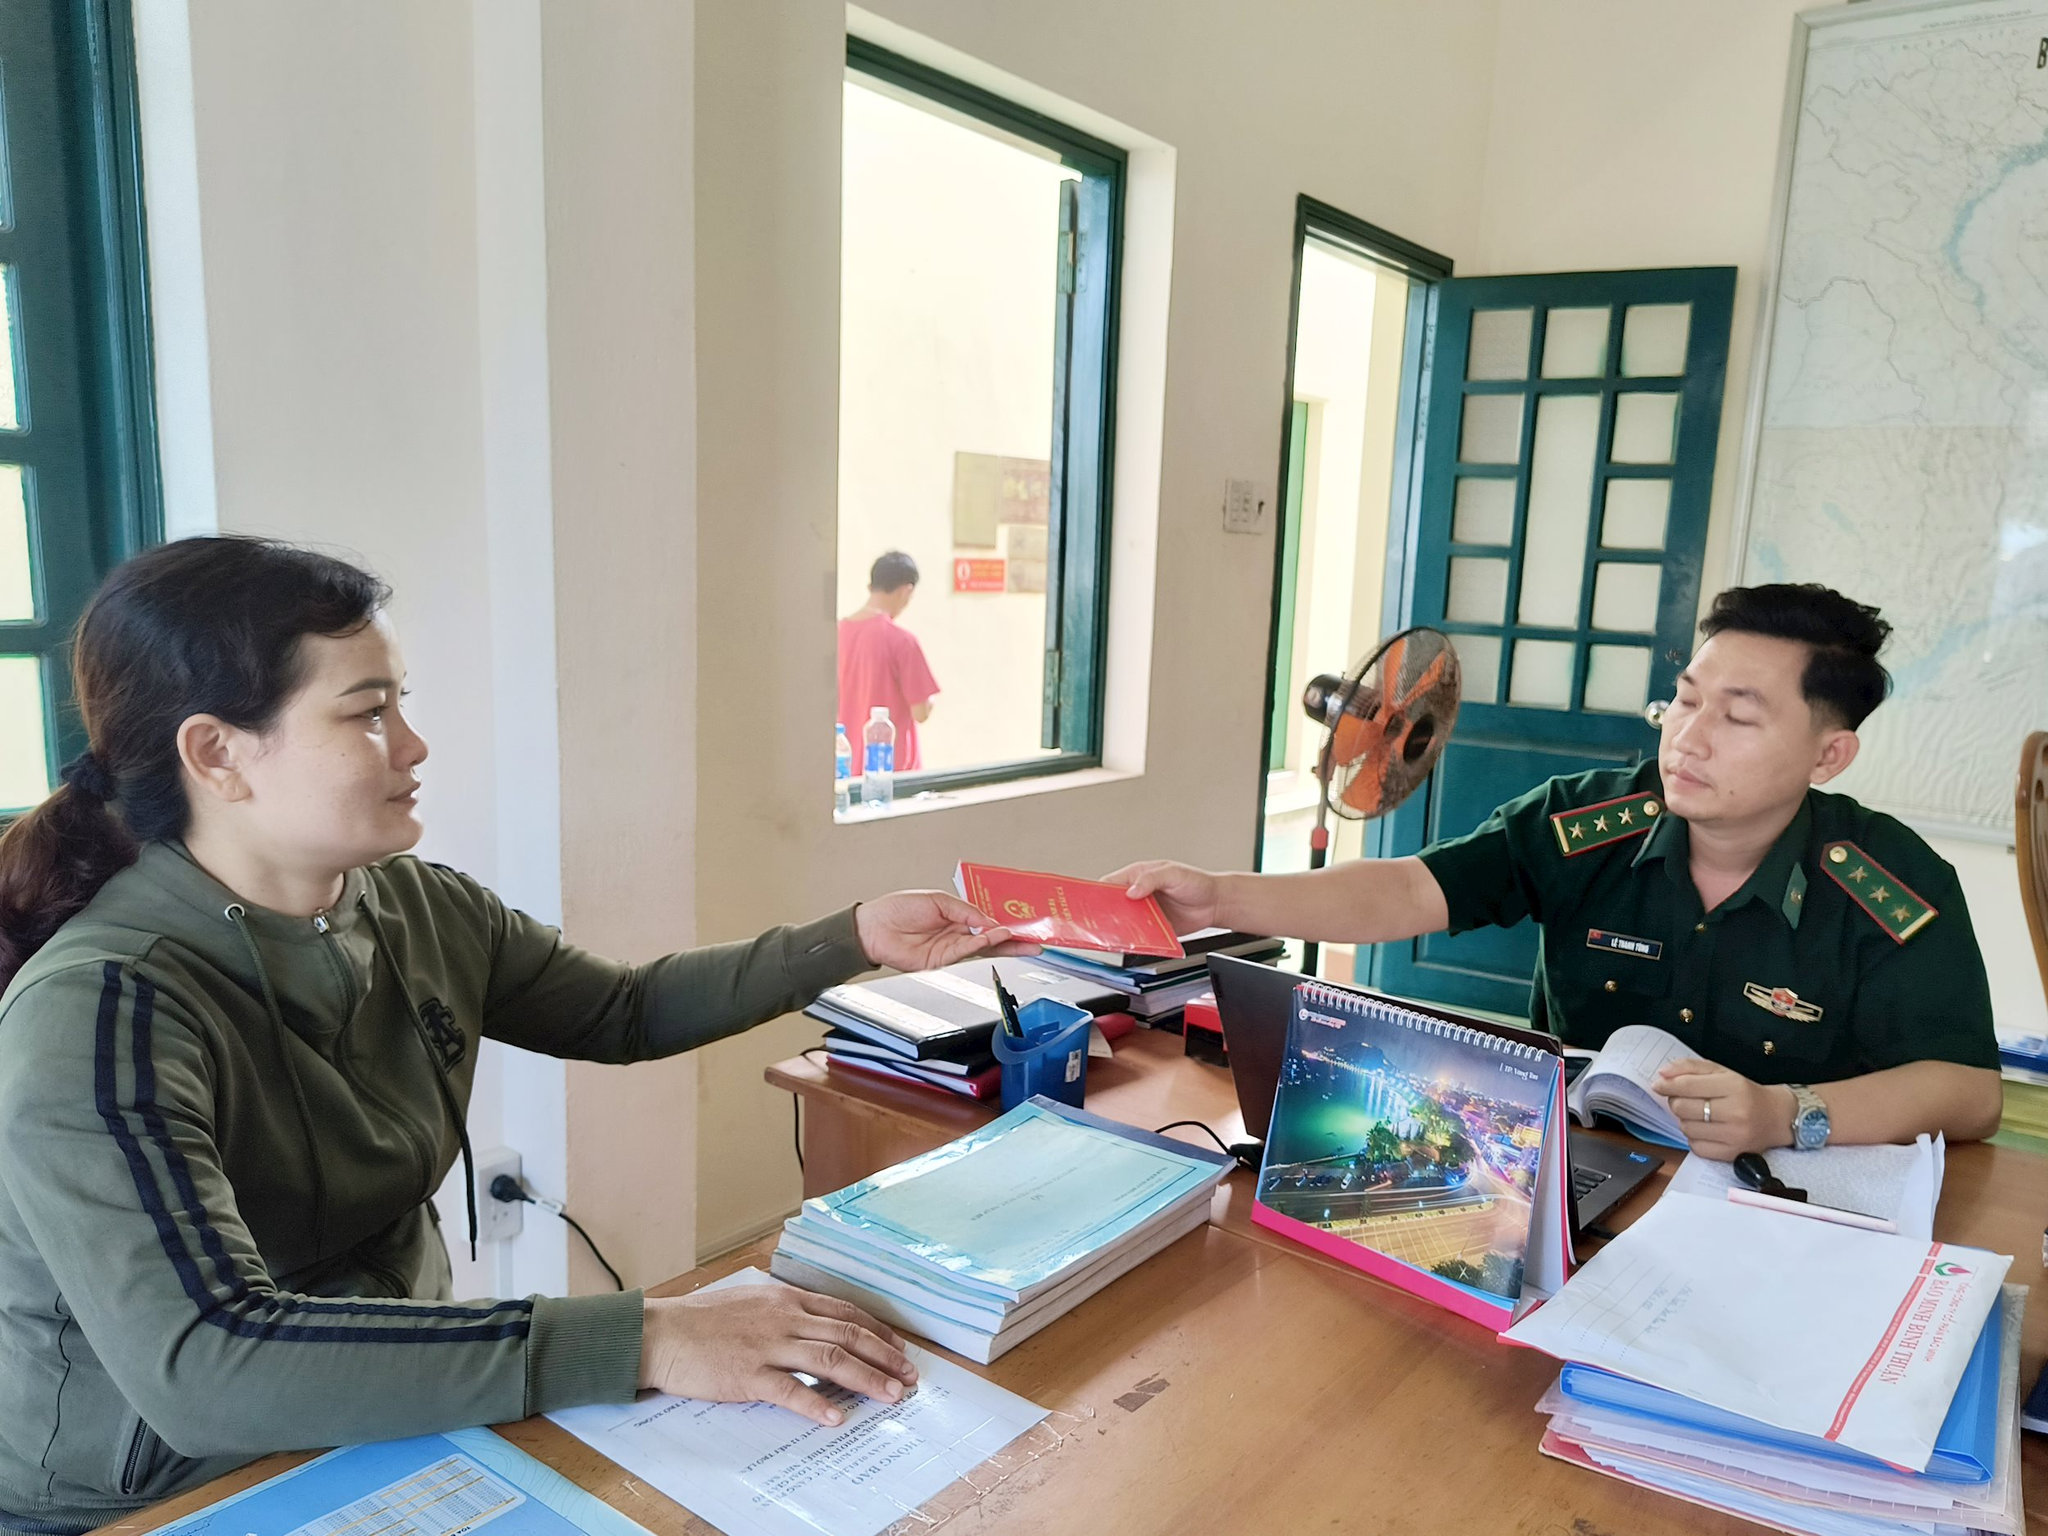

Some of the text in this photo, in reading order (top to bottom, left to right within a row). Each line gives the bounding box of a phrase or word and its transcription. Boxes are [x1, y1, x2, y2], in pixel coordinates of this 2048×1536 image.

[1911, 1297, 1940, 1322] MINH
[1897, 1323, 1929, 1350] BÌNH
[824, 1432, 850, 1448] PHAN
[828, 1436, 859, 1456] PHOTO
[850, 1437, 926, 1486] THÔNG BÁO
